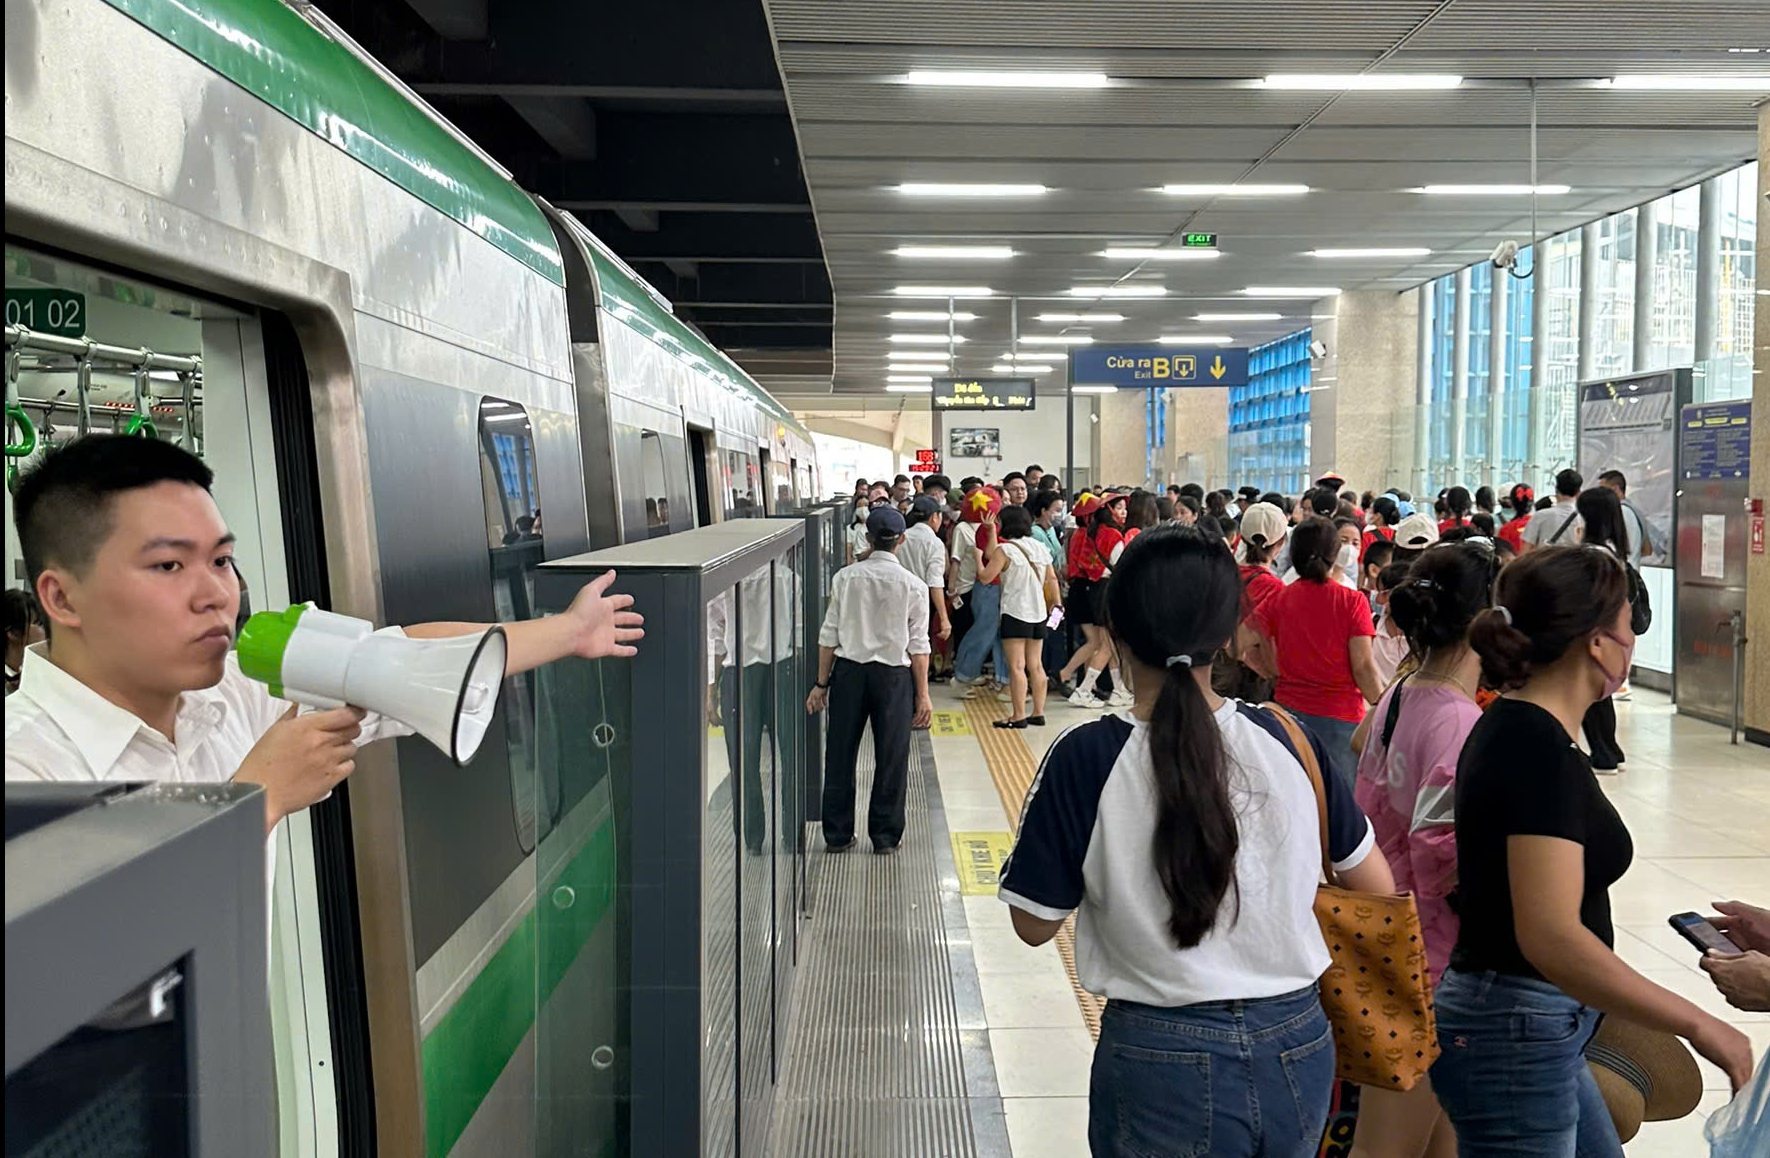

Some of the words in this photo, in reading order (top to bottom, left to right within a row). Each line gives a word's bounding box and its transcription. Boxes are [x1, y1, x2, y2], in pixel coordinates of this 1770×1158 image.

[1188, 234, 1211, 242] EXIT
[5, 298, 34, 328] 01
[47, 299, 80, 328] 02
[1106, 355, 1134, 369] Cửa
[1138, 357, 1151, 369] ra
[1152, 357, 1171, 379] B
[1134, 370, 1151, 380] Exit
